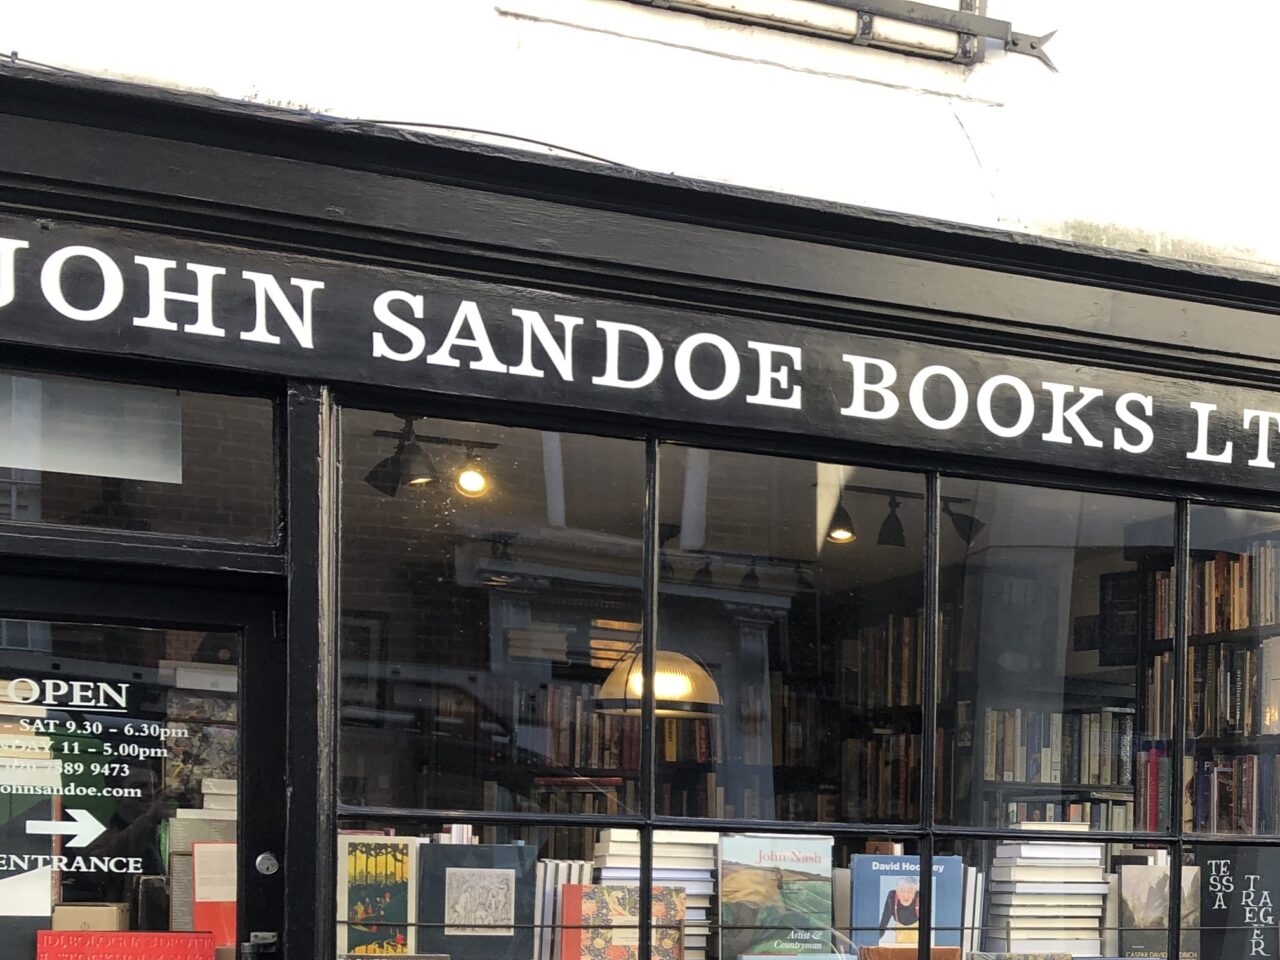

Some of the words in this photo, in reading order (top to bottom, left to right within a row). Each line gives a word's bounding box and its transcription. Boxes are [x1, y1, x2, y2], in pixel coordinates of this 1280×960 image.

[372, 290, 803, 410] SANDOE
[840, 354, 1155, 454] BOOKS
[7, 678, 130, 708] OPEN
[20, 718, 59, 733] SAT
[66, 720, 102, 735] 9.30
[124, 722, 189, 741] 6.30pm
[62, 741, 80, 755] 11
[103, 742, 168, 760] 5.00pm
[91, 763, 130, 777] 9473
[756, 849, 787, 864] John
[790, 850, 821, 864] Nash
[872, 861, 900, 871] David
[902, 861, 944, 873] Hocey
[786, 930, 810, 940] Artist
[774, 940, 822, 950] Countryman
